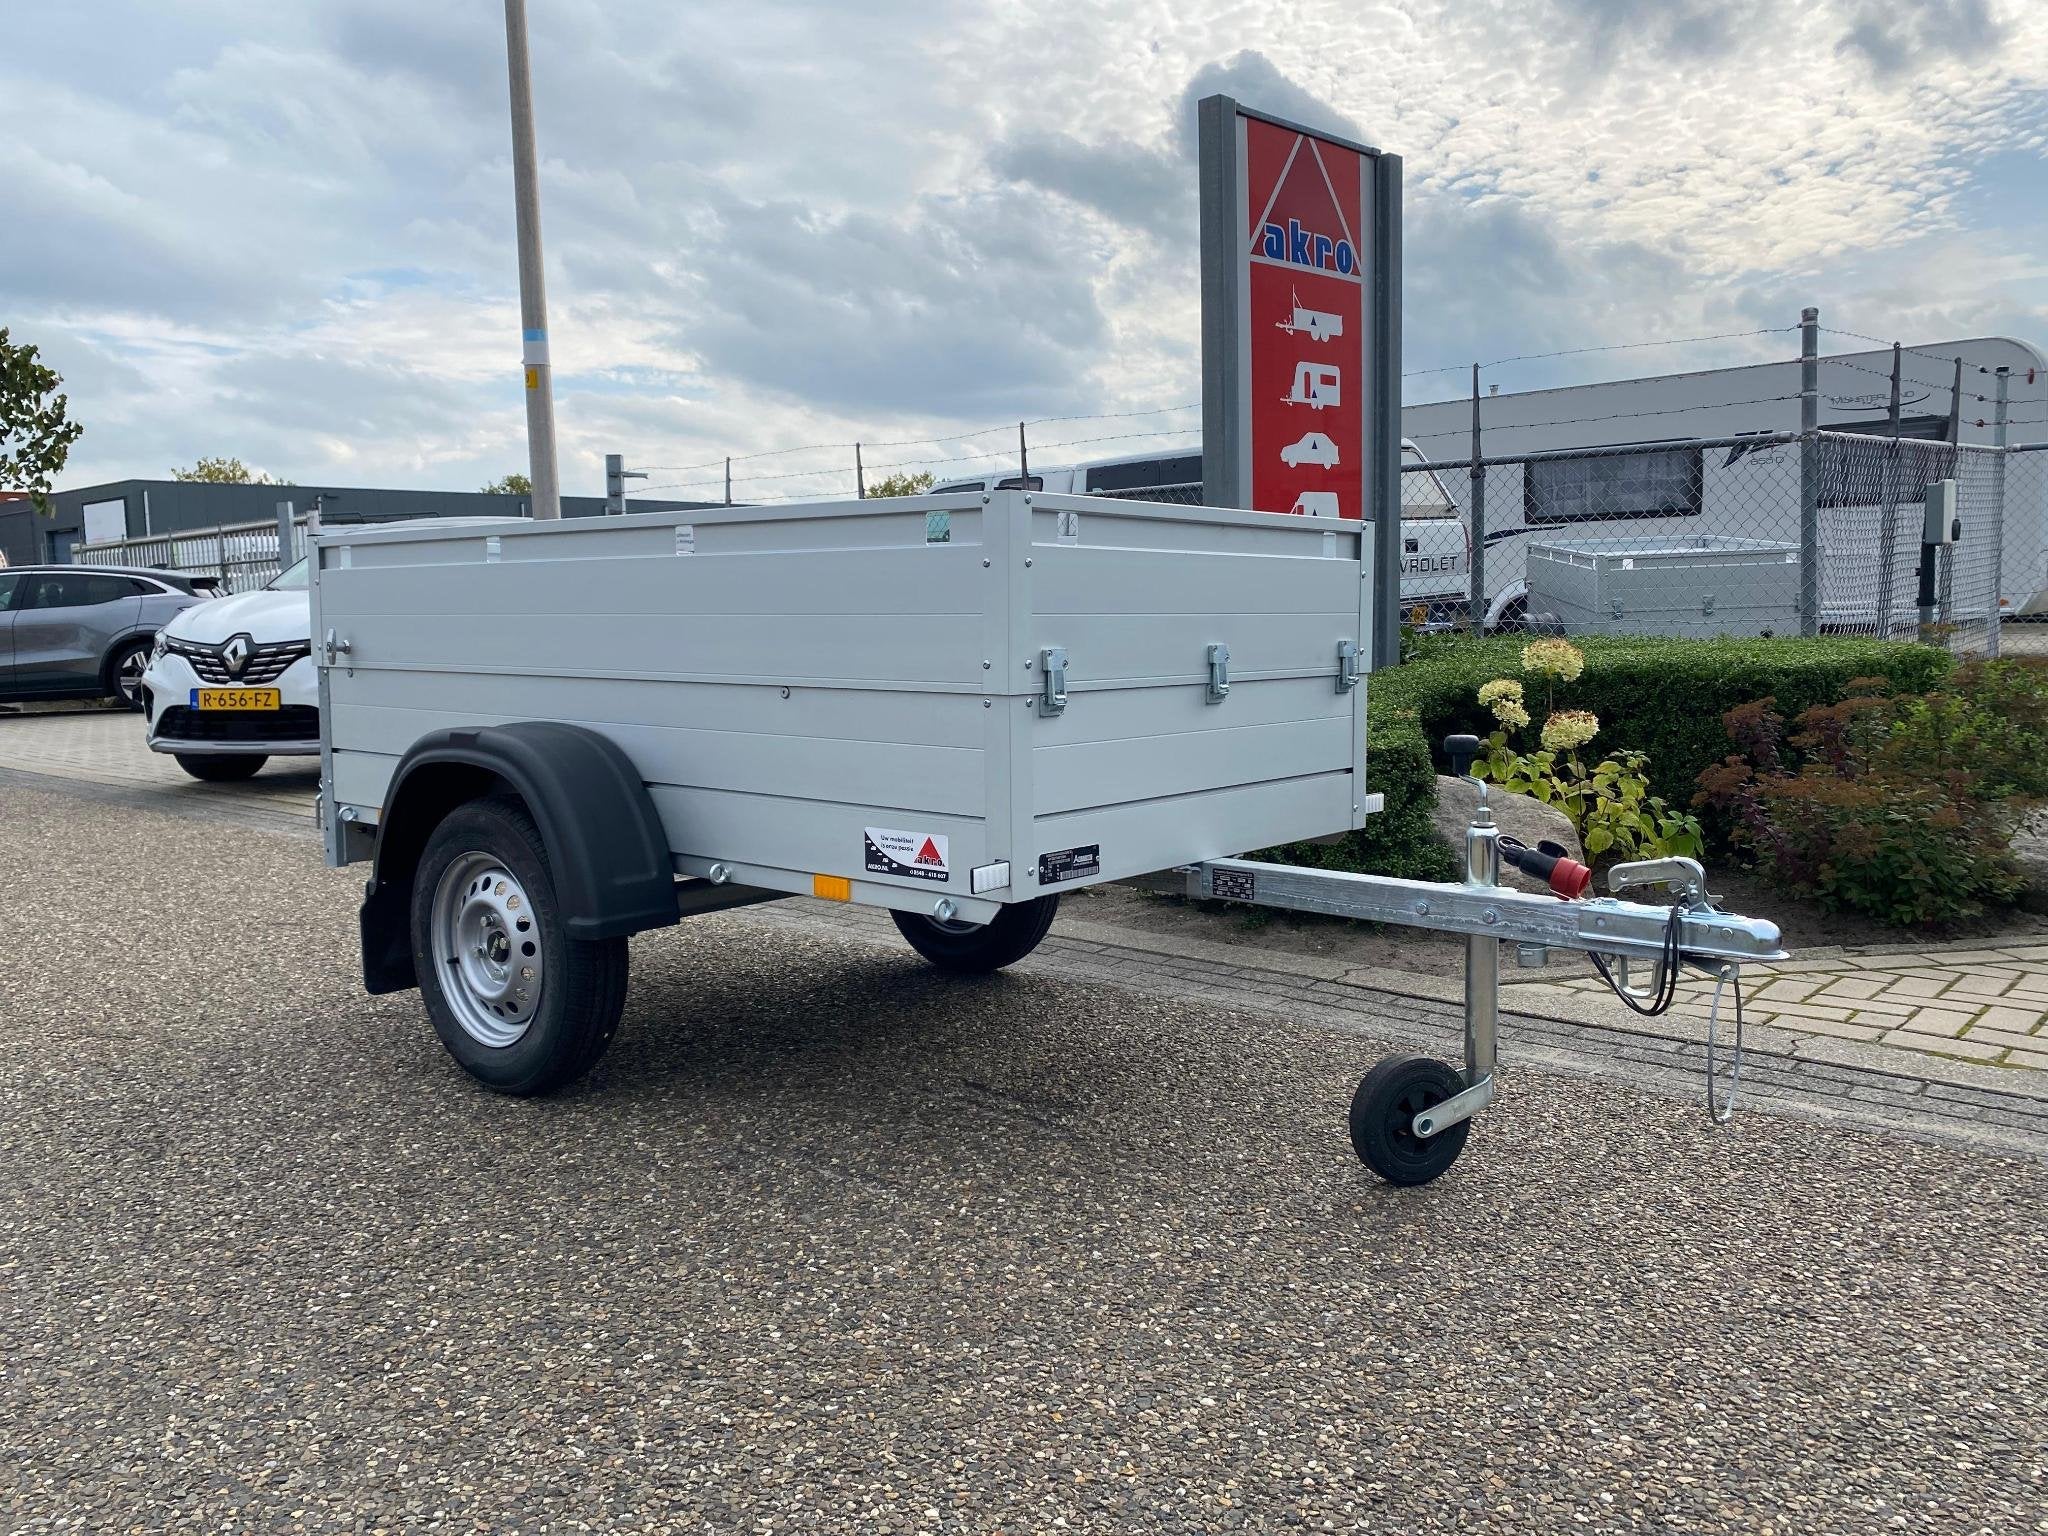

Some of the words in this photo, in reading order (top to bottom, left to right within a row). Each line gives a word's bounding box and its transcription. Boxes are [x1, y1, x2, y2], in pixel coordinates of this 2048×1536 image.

[1263, 217, 1353, 275] akro
[1400, 556, 1458, 573] VROLET
[203, 692, 272, 707] R-656-FZ
[917, 855, 943, 867] akro
